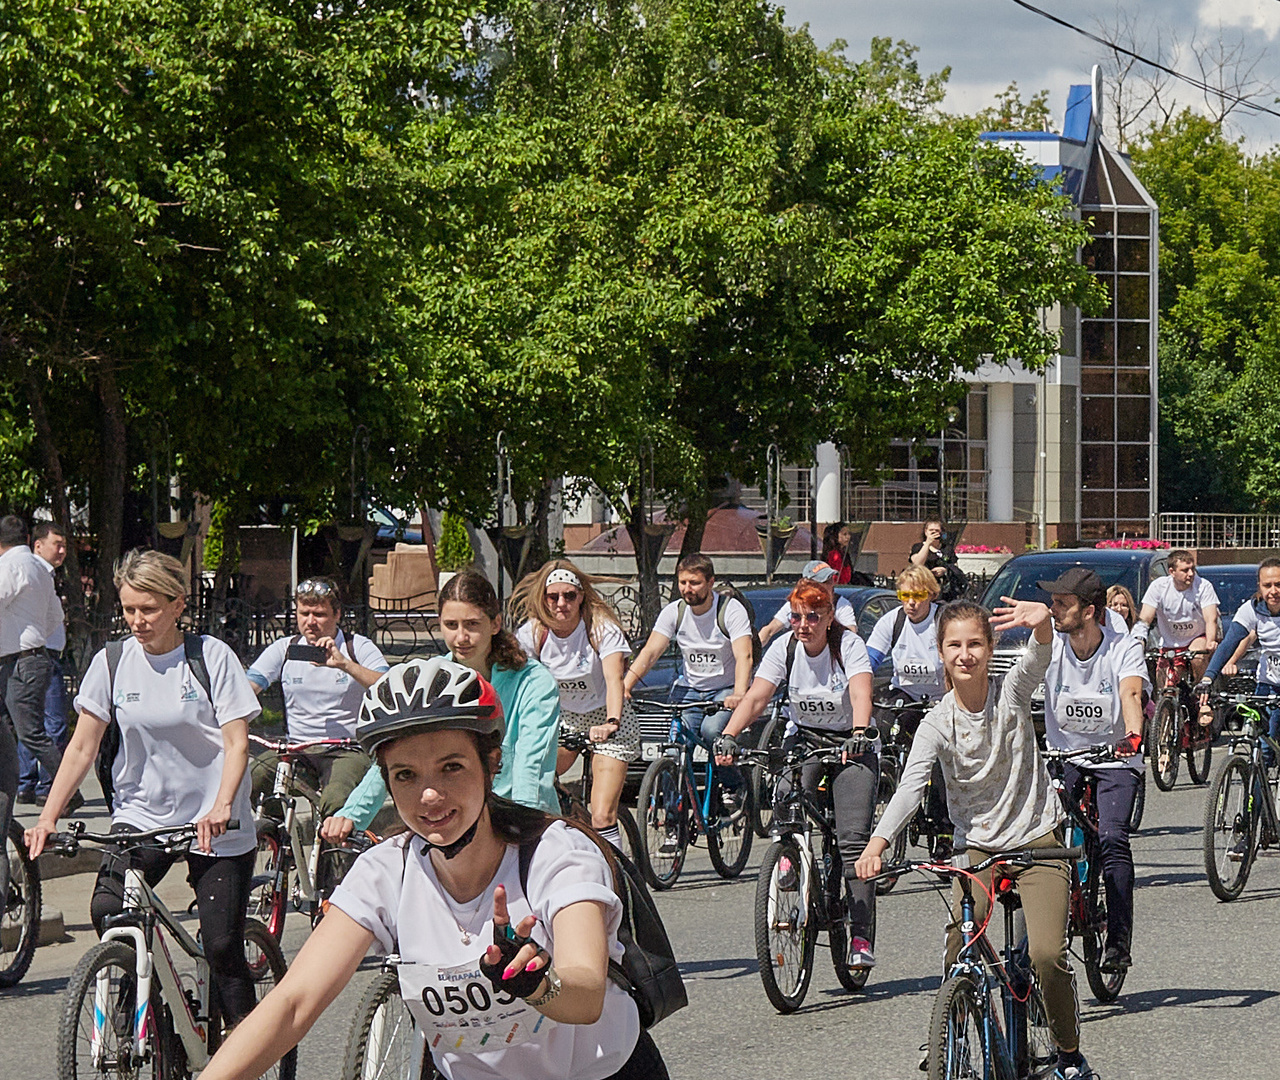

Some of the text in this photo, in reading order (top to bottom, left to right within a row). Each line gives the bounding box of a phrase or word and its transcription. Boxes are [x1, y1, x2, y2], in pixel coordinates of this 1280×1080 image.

[689, 653, 717, 663] 0512
[903, 665, 929, 675] 0511
[558, 680, 587, 690] 028
[799, 701, 836, 712] 0513
[1066, 705, 1103, 718] 0509
